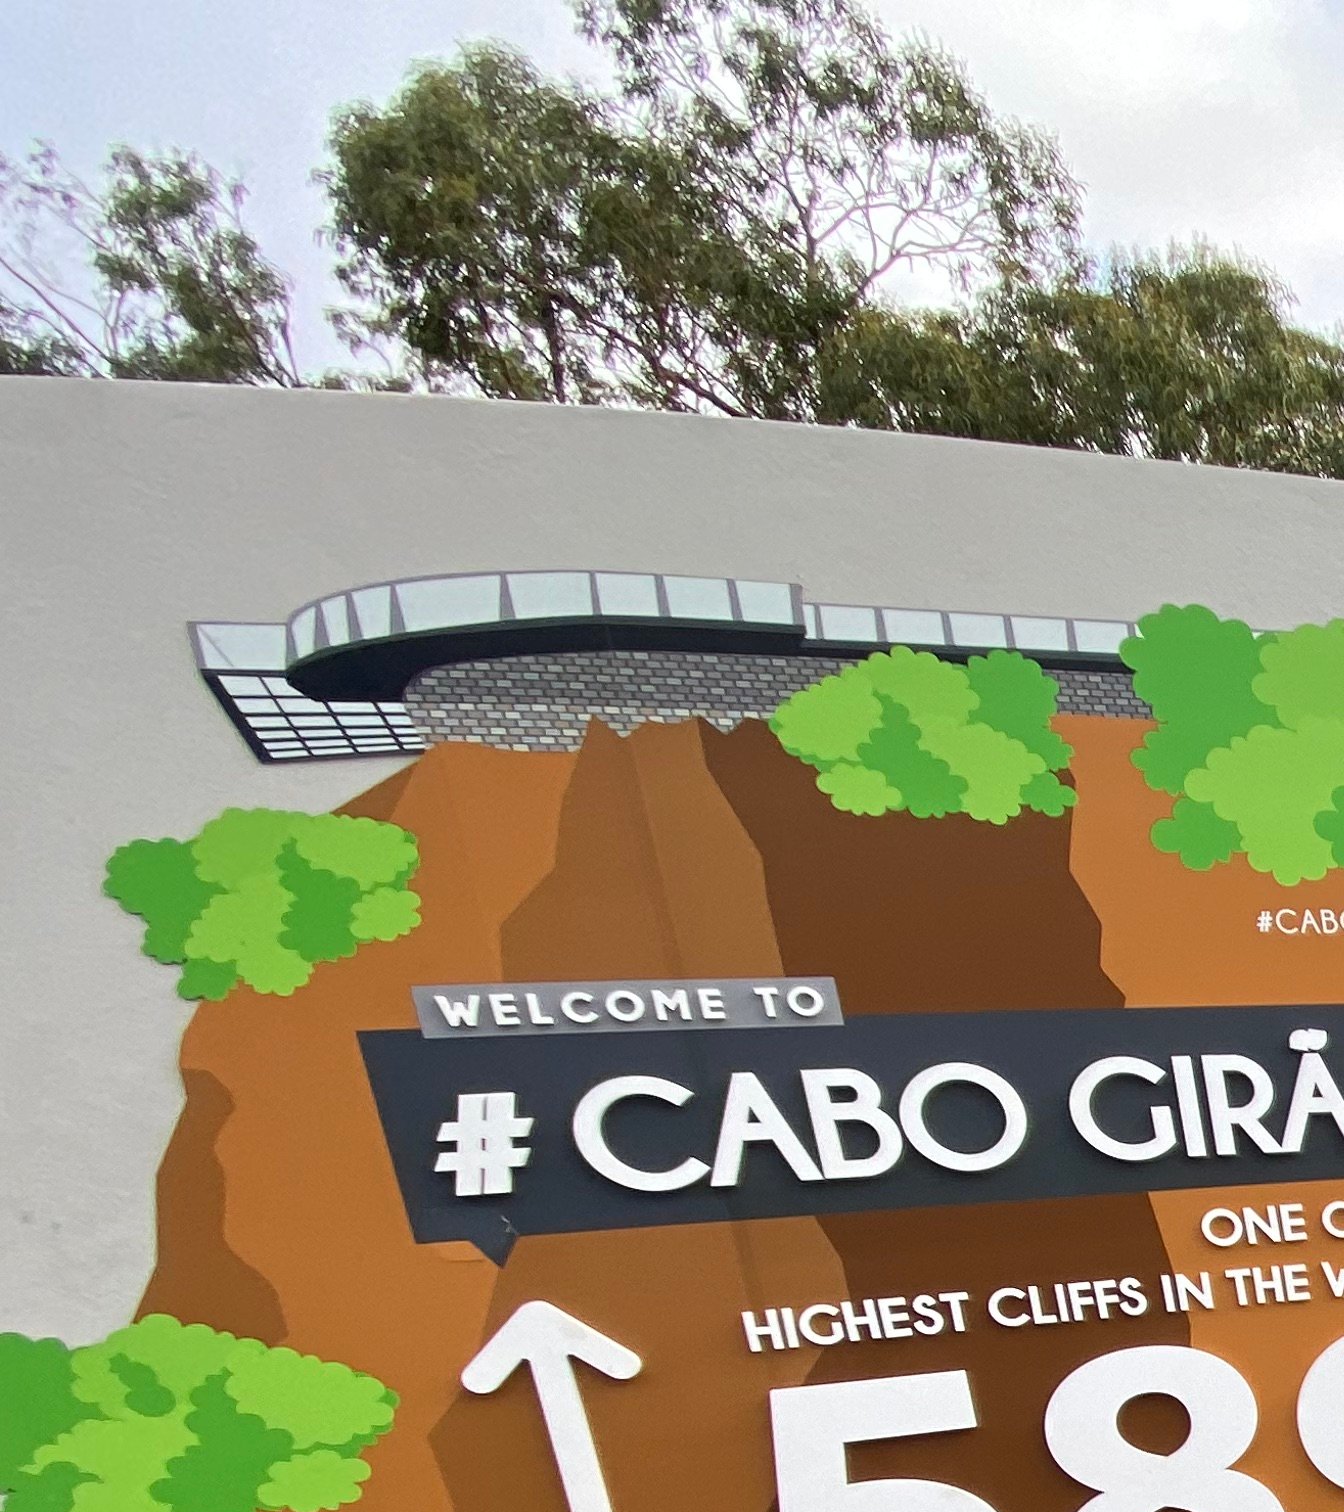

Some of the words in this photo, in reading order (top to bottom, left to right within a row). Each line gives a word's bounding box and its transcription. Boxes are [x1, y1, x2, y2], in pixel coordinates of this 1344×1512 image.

[436, 988, 726, 1027] WELCOME
[754, 986, 824, 1017] TO
[573, 1062, 1027, 1192] CABO
[1201, 1203, 1306, 1247] ONE
[742, 1291, 967, 1352] HIGHEST
[988, 1277, 1148, 1328] CLIFFS
[1161, 1271, 1215, 1313] IN
[1224, 1263, 1311, 1304] THE
